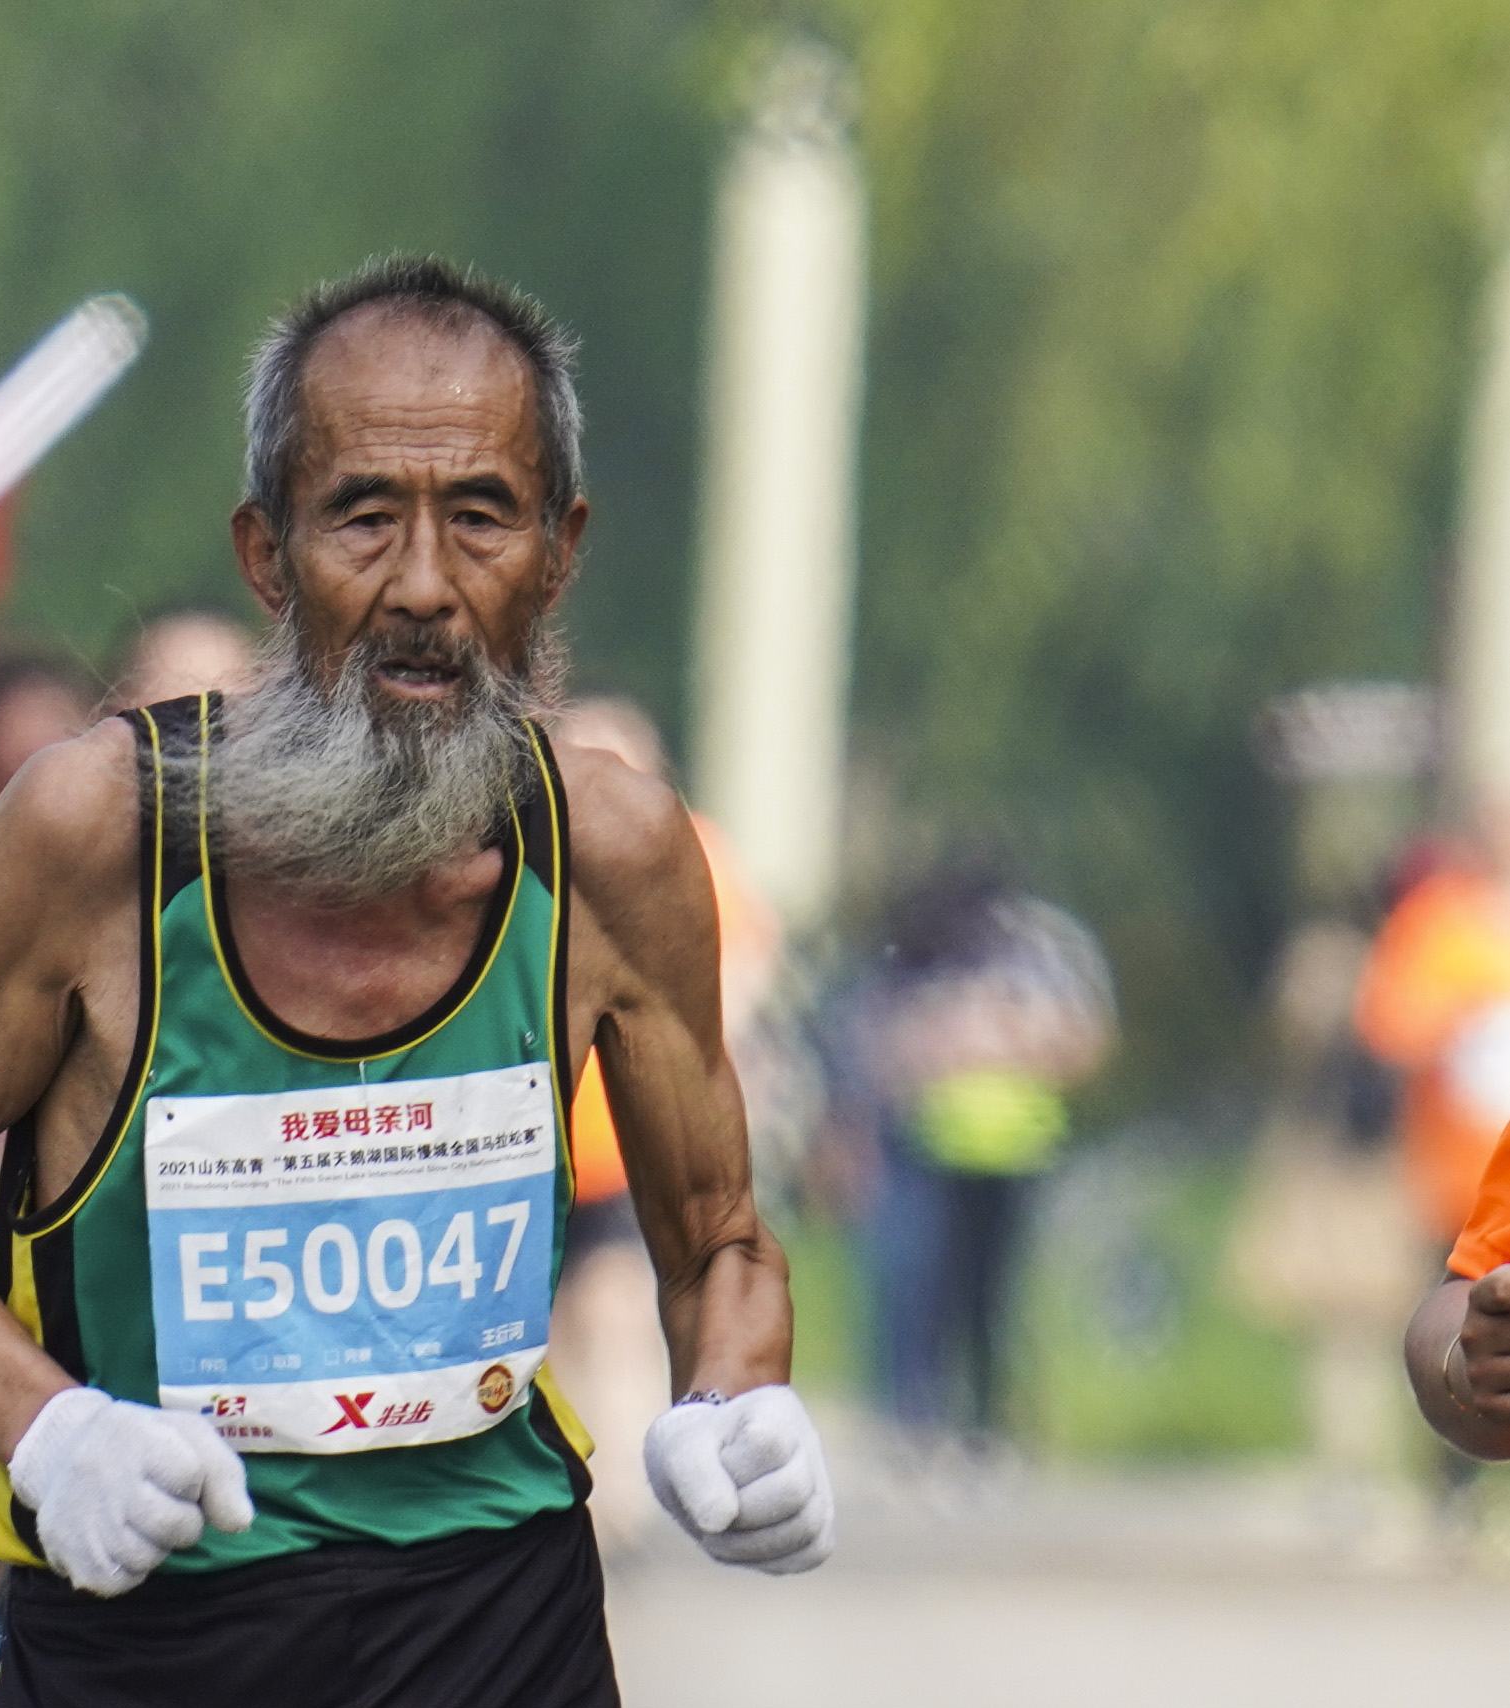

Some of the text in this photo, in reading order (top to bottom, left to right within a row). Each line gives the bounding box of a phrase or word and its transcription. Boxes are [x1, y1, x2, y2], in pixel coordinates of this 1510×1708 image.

[281, 1102, 434, 1143] 我爱母亲河
[159, 1157, 265, 1176] 2021山东高青
[179, 1200, 530, 1322] E50047
[373, 1399, 437, 1428] 特步
